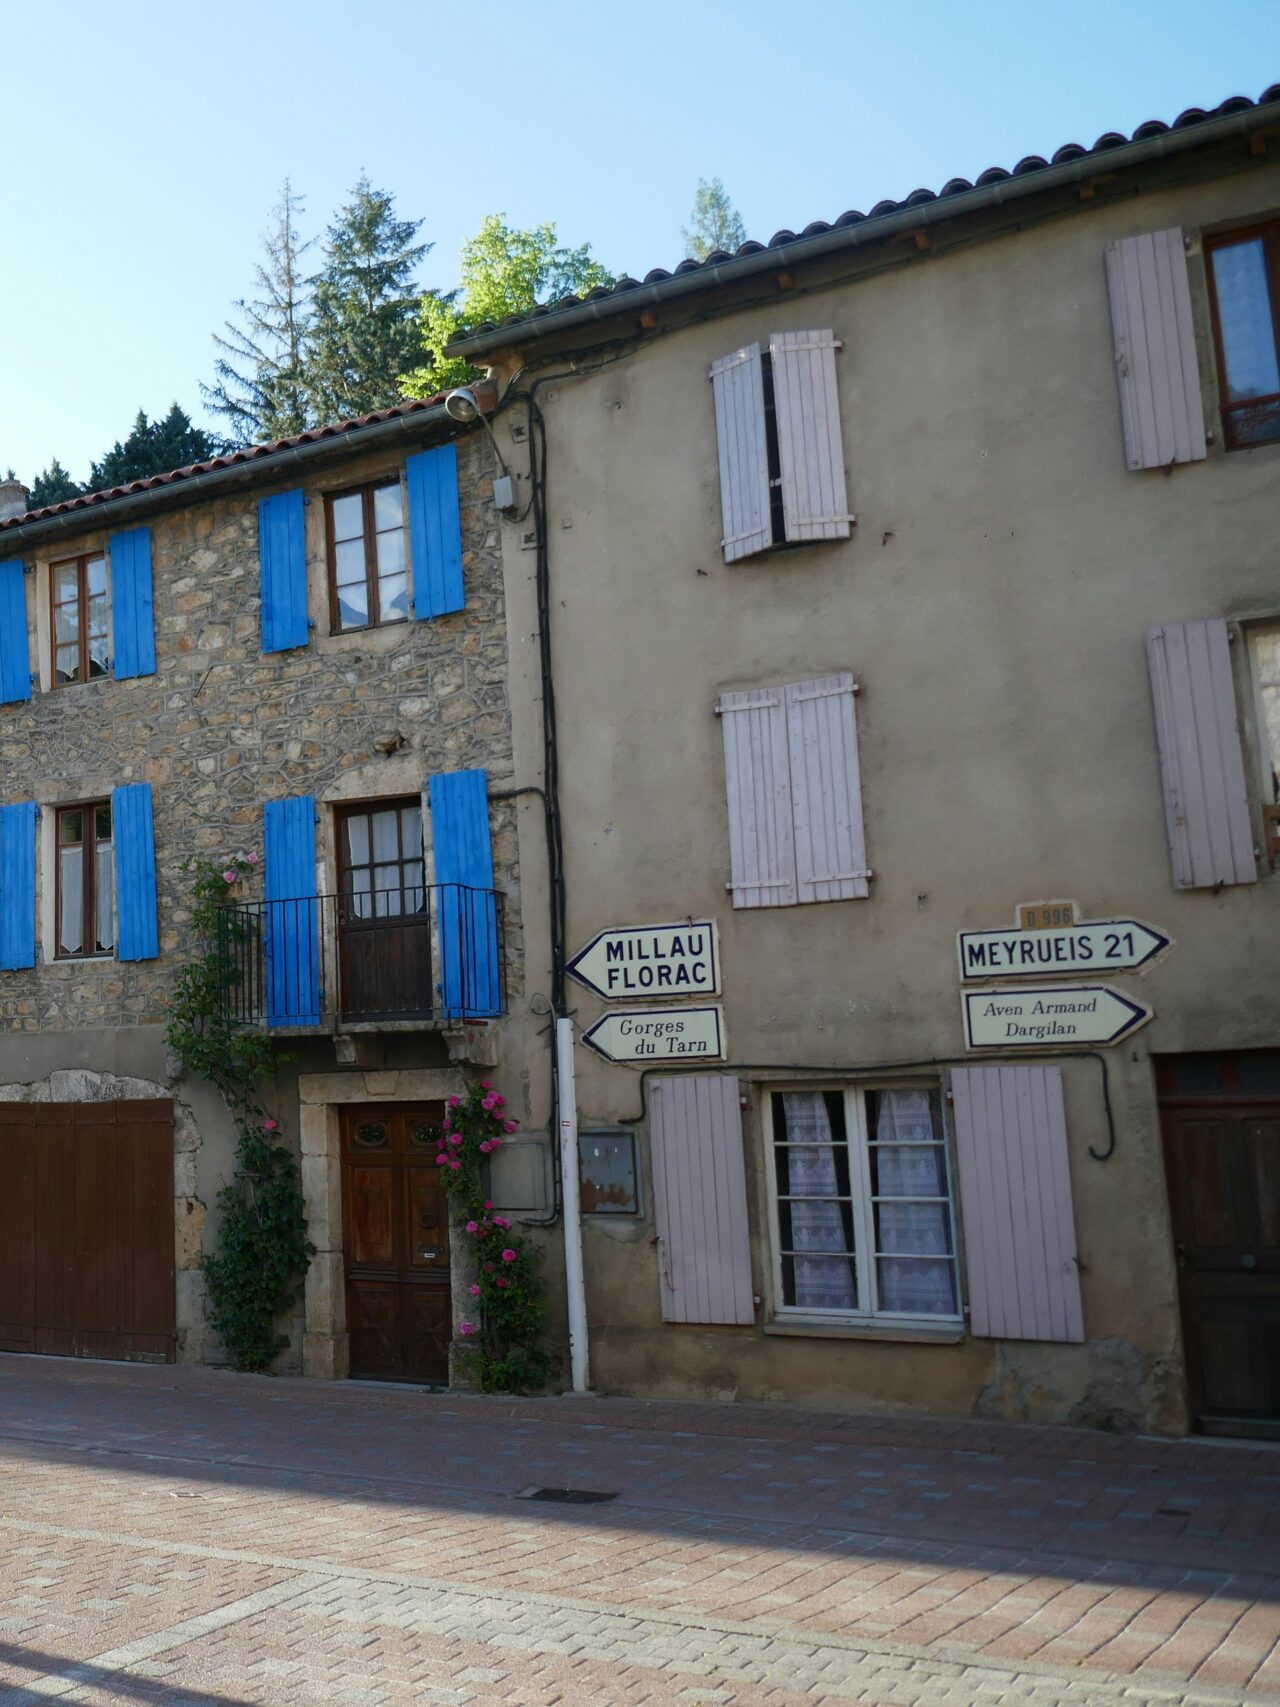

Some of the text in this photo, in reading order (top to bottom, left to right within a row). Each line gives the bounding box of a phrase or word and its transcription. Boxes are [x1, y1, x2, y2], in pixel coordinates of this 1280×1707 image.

[606, 934, 703, 962] MILLAU
[967, 933, 1134, 967] MEYRUEIS 21
[608, 962, 707, 989] FLORAC
[983, 998, 1097, 1017] Aven Armand
[620, 1020, 684, 1037] Gorges
[1005, 1021, 1076, 1039] Dargilan
[635, 1037, 707, 1054] du Tarn
